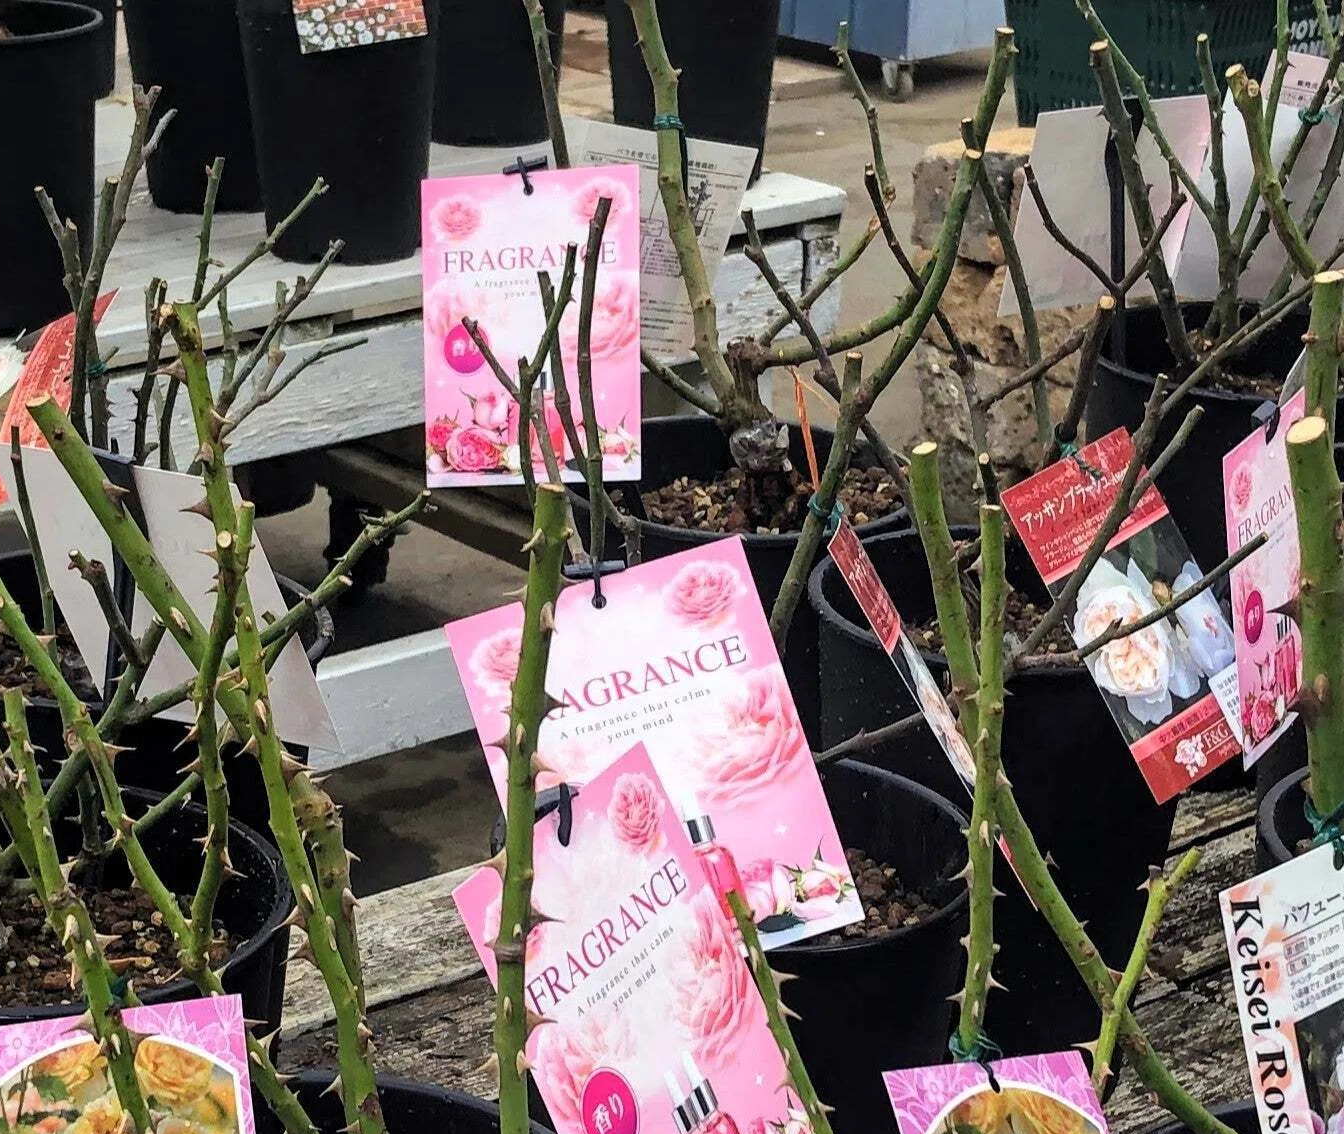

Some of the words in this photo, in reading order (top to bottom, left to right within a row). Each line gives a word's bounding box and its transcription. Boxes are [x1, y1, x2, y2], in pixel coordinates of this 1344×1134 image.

[1238, 484, 1293, 548] FRAGRAN
[546, 635, 747, 721] AGRANCE
[575, 711, 637, 736] fragrance
[644, 701, 669, 715] that
[674, 687, 711, 704] calms
[607, 727, 636, 744] your
[642, 714, 674, 731] mind
[527, 858, 687, 1016] FRAGRANCE
[586, 967, 629, 1008] fragrance
[630, 948, 649, 969] that
[650, 926, 674, 950] calms
[1229, 896, 1280, 1037] Keisei
[613, 987, 633, 1011] your
[635, 963, 657, 988] mind
